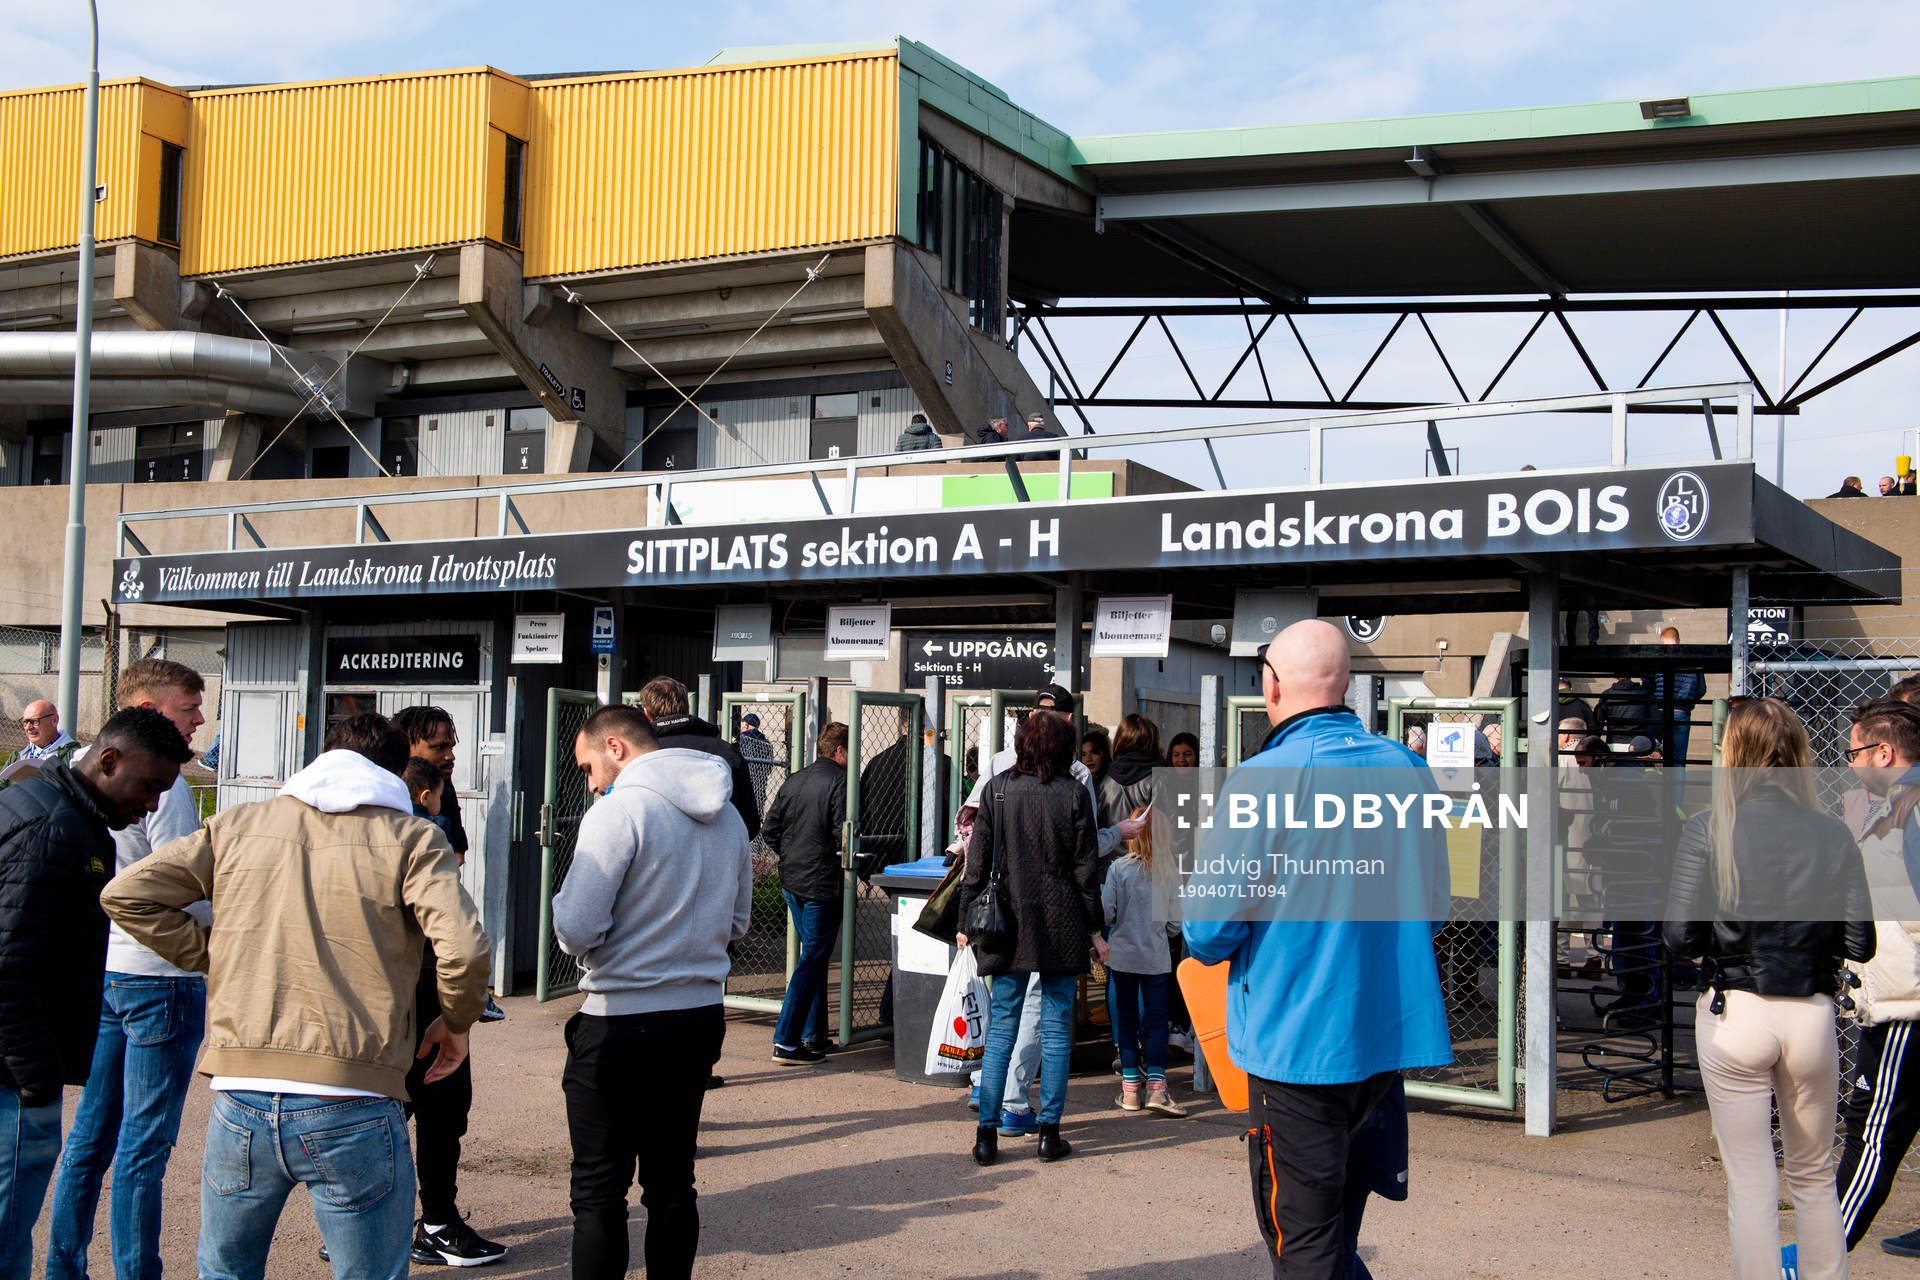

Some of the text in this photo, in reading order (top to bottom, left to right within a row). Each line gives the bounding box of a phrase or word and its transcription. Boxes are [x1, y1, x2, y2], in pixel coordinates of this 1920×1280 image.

[1160, 485, 1631, 553] Landskrona BOIS
[626, 532, 790, 575] SITTPLATS
[801, 525, 938, 569] sektion
[951, 523, 985, 561] A
[1029, 518, 1060, 558] H
[158, 550, 557, 592] Välkommen till Landskrona Idrottsplats
[1109, 610, 1154, 622] Biljetter
[1731, 607, 1786, 619] KTION
[839, 618, 876, 627] Biljetter
[517, 632, 559, 640] Funktionärer
[831, 637, 884, 646] Abonnemang
[1098, 631, 1163, 642] Abonnemang
[525, 645, 549, 653] Spelare
[948, 636, 1048, 659] UPPGÅNG
[339, 651, 465, 671] ACKREDITERING
[913, 662, 954, 673] Sektion
[956, 662, 963, 673] E
[973, 662, 982, 673] H
